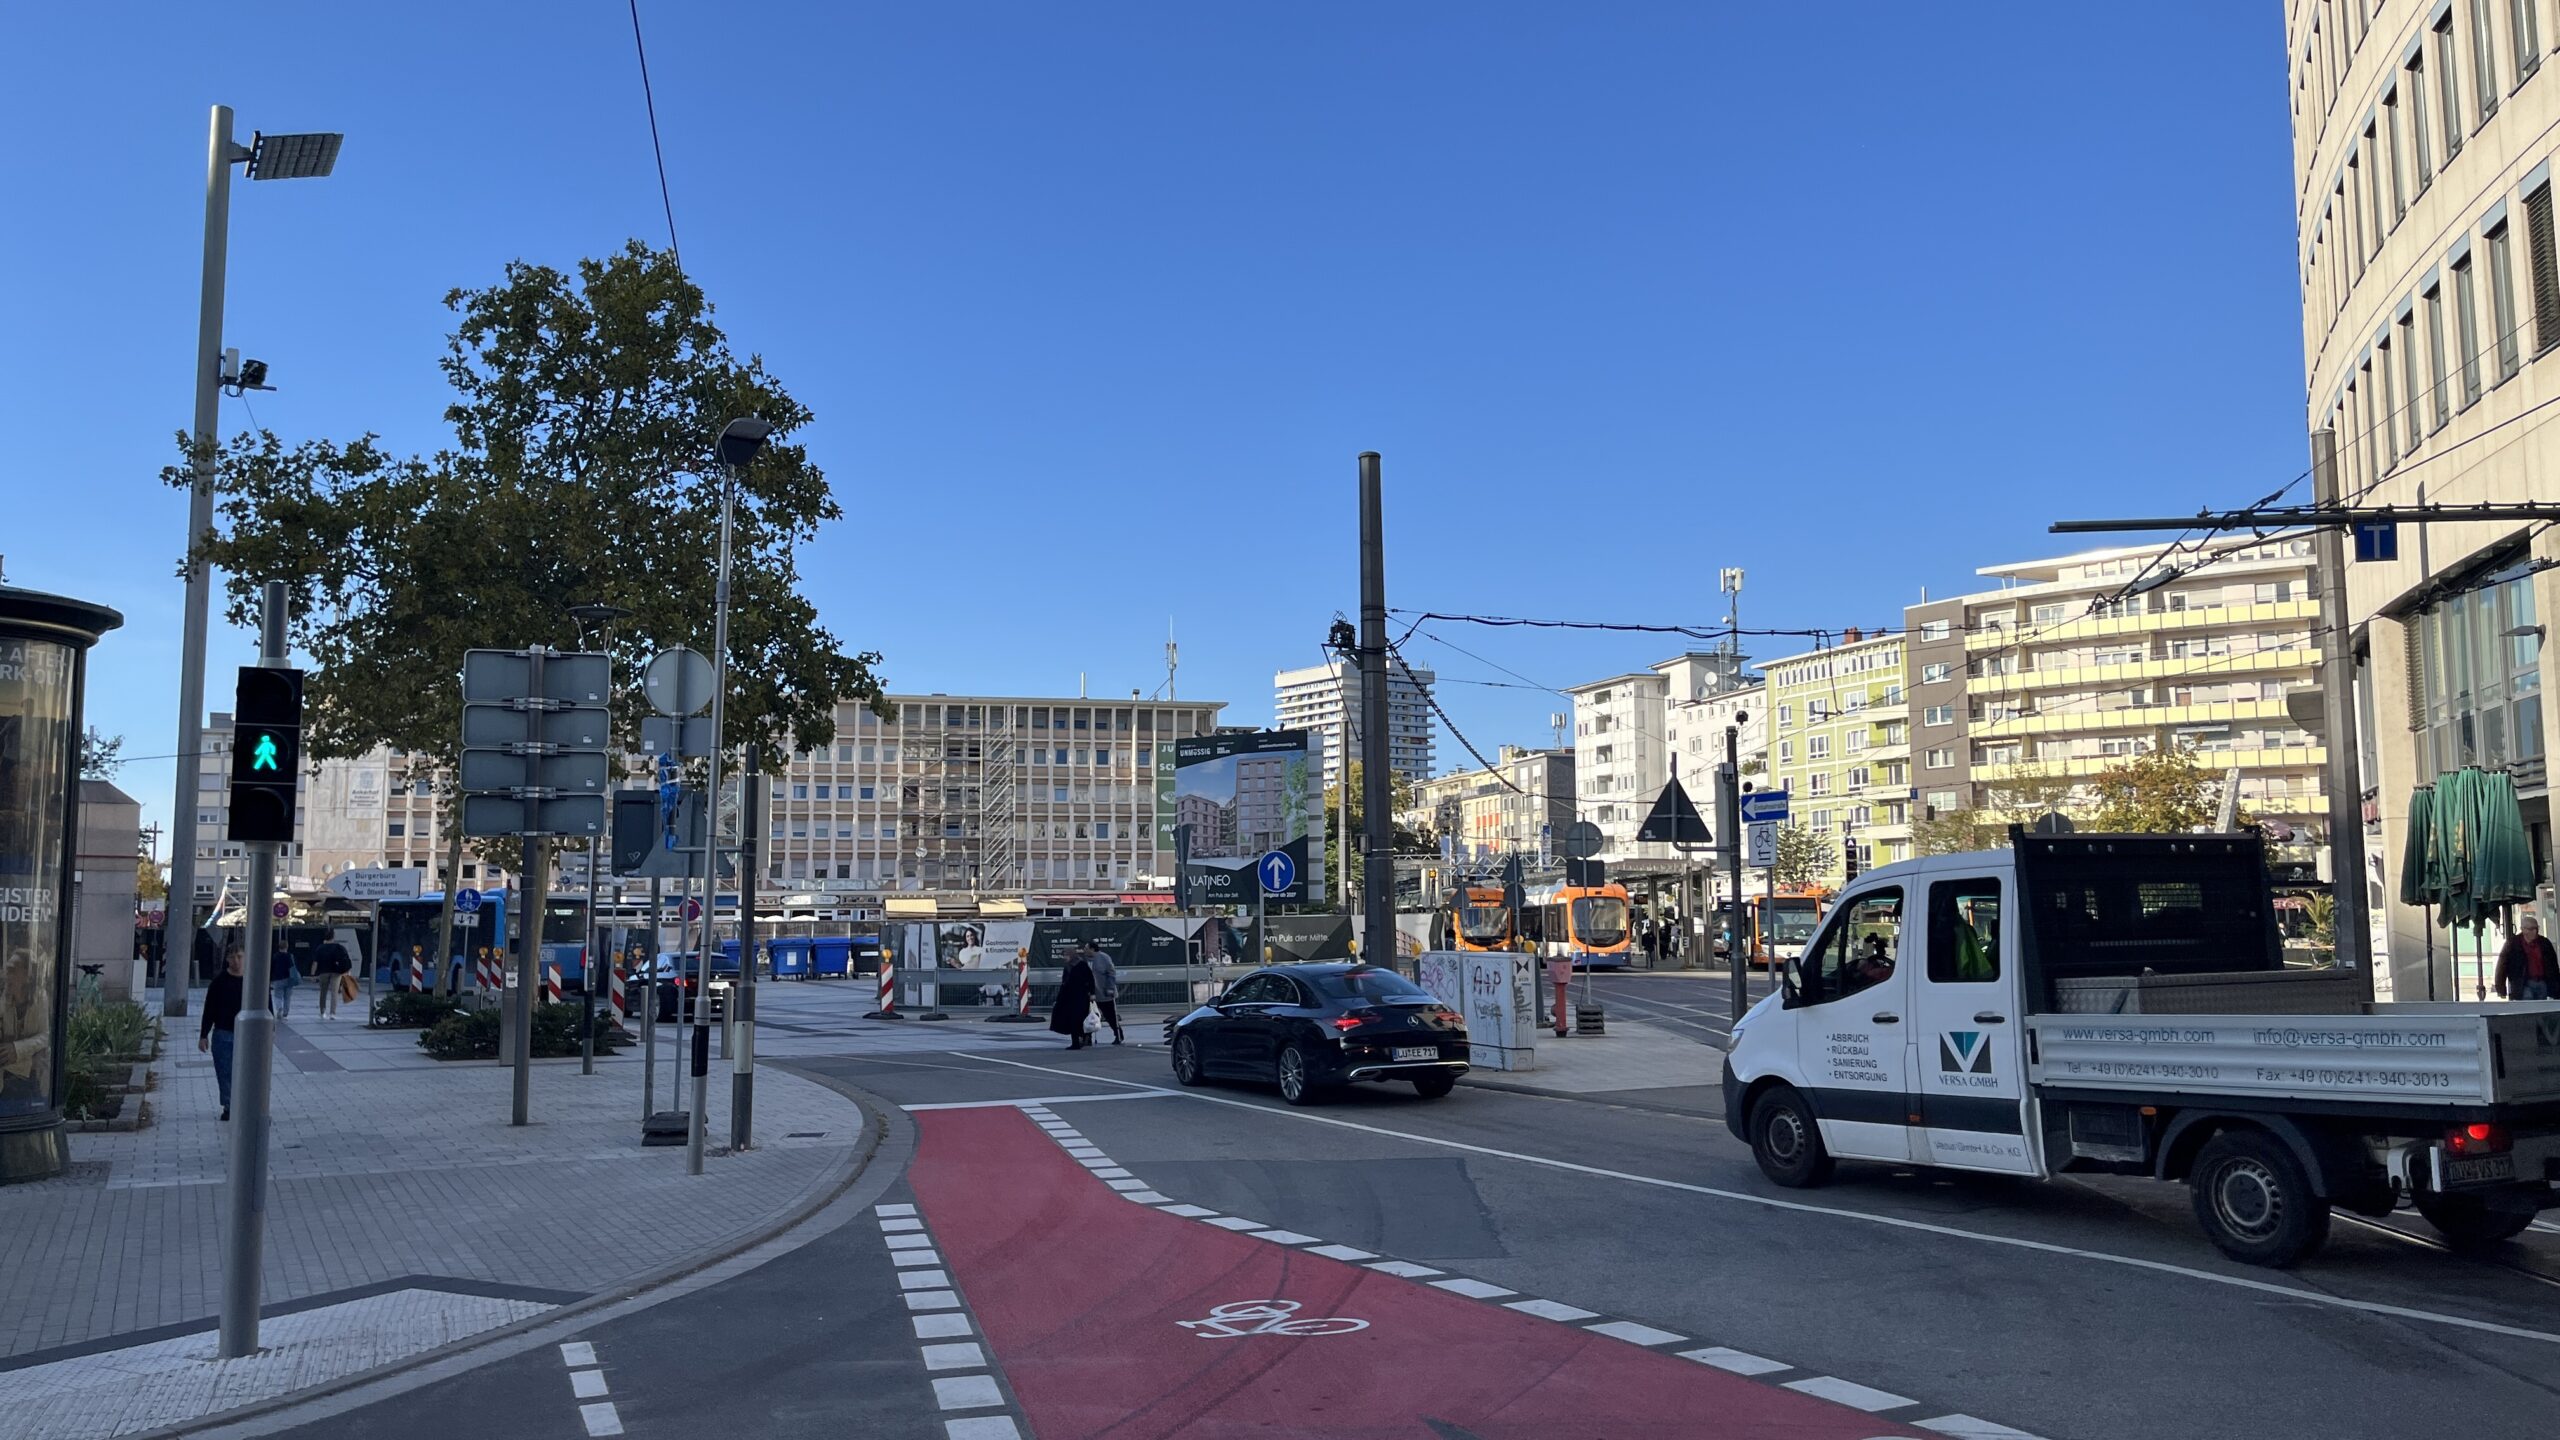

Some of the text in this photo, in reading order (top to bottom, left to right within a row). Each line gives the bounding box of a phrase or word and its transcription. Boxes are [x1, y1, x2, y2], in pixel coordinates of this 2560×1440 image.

[355, 872, 396, 880] Bürgerbüro
[1263, 934, 1278, 942] Am
[1278, 933, 1294, 943] Puls
[1294, 934, 1308, 942] der
[1831, 1033, 1869, 1043] ABBRUCH
[2063, 1027, 2215, 1045] www.versa-gmbh.com
[2253, 1027, 2446, 1048] info@versa-gmbh.com
[1831, 1044, 1869, 1055] RÜCKBAU
[1832, 1058, 1877, 1069] SANIERUNG
[1834, 1070, 1888, 1082] ENTSORGUNG
[1938, 1074, 1999, 1089] VERSA GMBH
